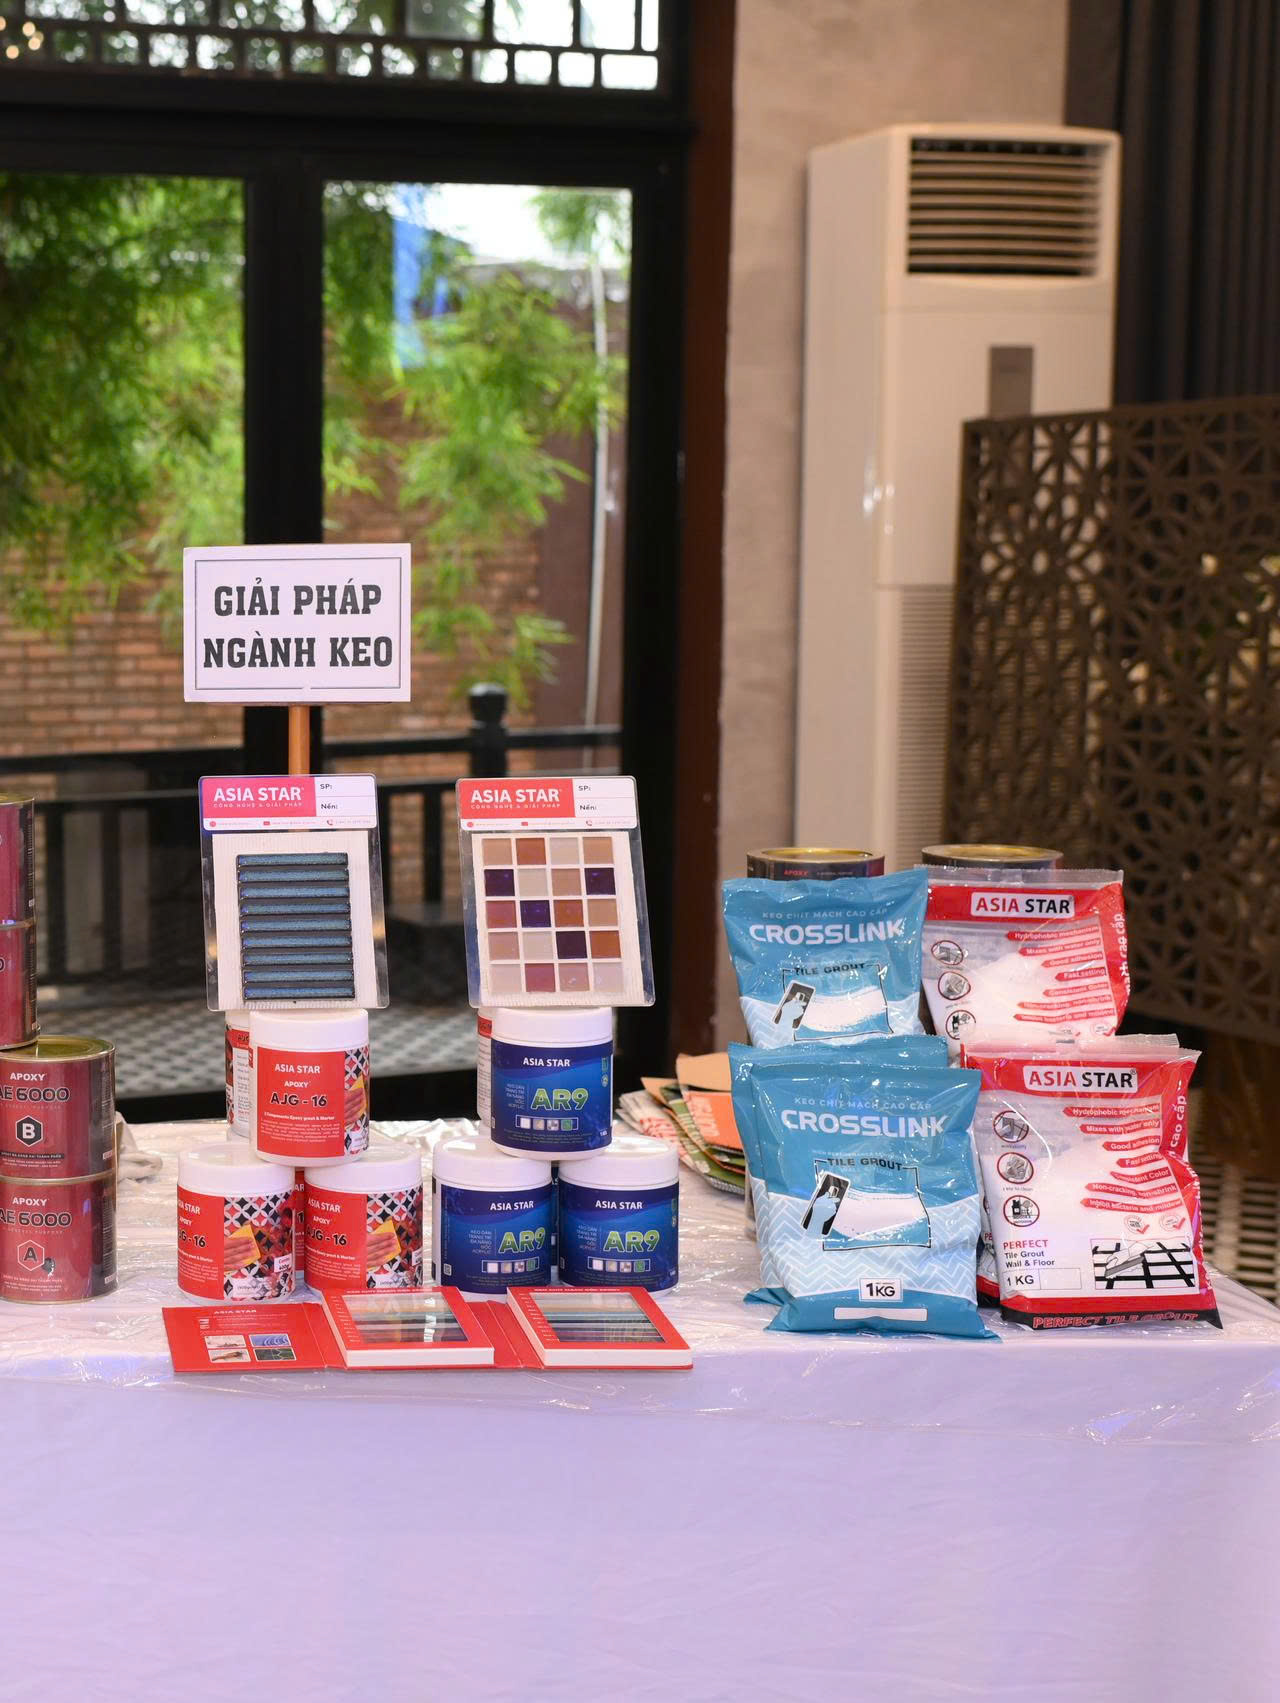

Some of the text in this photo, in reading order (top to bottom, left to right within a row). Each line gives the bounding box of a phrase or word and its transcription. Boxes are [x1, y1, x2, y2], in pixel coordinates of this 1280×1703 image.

[214, 577, 382, 617] GIẢI PHÁP
[203, 630, 393, 669] NGÀNH KEO
[214, 787, 302, 801] ASIA STAR
[471, 789, 560, 803] ASIA STAR
[976, 897, 1070, 914] ASIA STAR
[749, 919, 906, 945] CROSSLINK
[794, 963, 865, 976] TILE GROUT
[275, 1064, 320, 1074] ASIA STAR
[523, 1057, 570, 1067] ASIA STAR
[10, 1072, 45, 1081] APOXY
[1029, 1071, 1077, 1087] ASIA
[16, 1087, 70, 1103] 6000
[270, 1092, 328, 1107] AJG 16
[531, 1088, 589, 1110] AR9
[883, 1102, 905, 1110] CAO
[1073, 1107, 1117, 1116] Hydrophobic
[781, 1109, 949, 1138] CROSSLINK
[1143, 1119, 1160, 1128] only
[22, 1123, 35, 1139] B
[1170, 1124, 1183, 1148] cao
[827, 1157, 902, 1171] TILE GROUT
[1149, 1169, 1169, 1178] Color
[12, 1198, 47, 1207] APOXY
[185, 1203, 201, 1215] STAR
[308, 1199, 341, 1213] ASIA STAR
[490, 1200, 534, 1211] ASIA STAR
[595, 1200, 643, 1210] ASIA STAR
[19, 1211, 72, 1227] 6000
[313, 1215, 330, 1225] APOXY
[194, 1235, 206, 1248] 16
[333, 1233, 347, 1246] 16
[498, 1227, 546, 1254] AR9
[603, 1229, 660, 1253] AR9
[1003, 1239, 1049, 1251] PERFECT
[24, 1247, 38, 1262] A
[1020, 1250, 1045, 1258] Grout
[1015, 1275, 1035, 1285] KG
[1032, 1315, 1103, 1329] PERFECT
